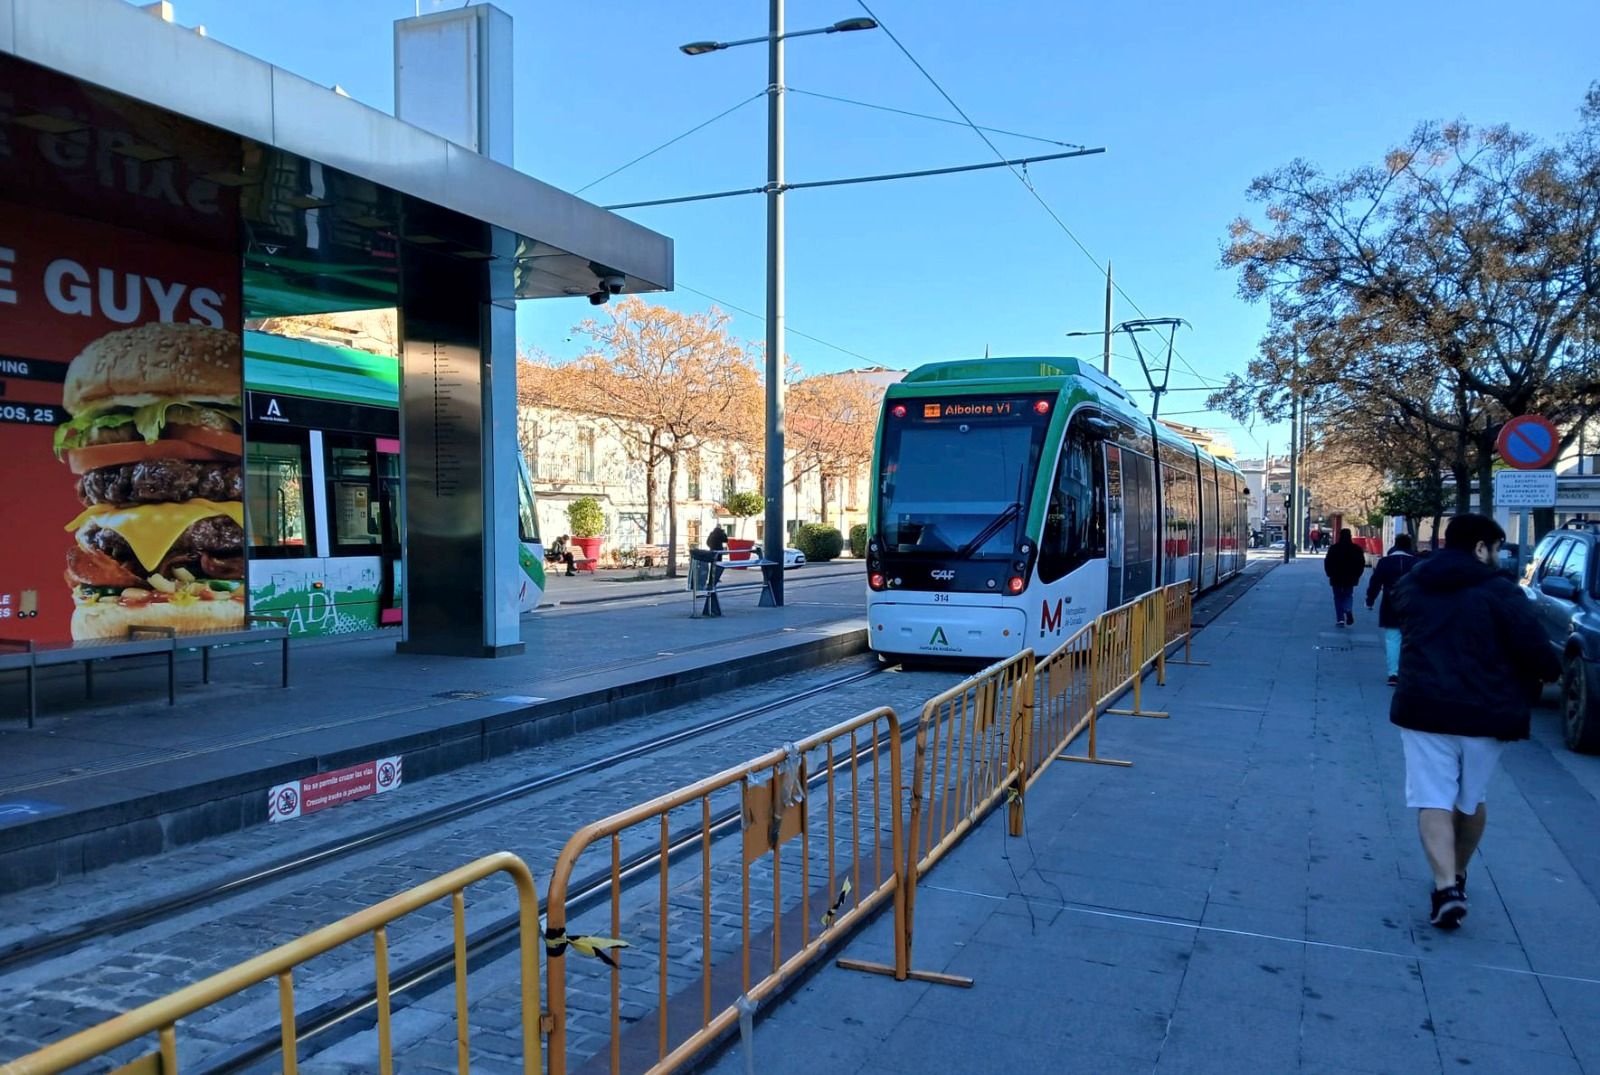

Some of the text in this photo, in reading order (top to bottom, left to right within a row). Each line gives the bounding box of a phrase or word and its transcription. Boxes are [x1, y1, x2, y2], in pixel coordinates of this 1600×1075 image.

[43, 258, 224, 330] GUYS
[0, 360, 28, 375] ING
[33, 408, 54, 422] 25
[945, 402, 1010, 415] Albolote V1
[930, 569, 956, 580] CAF
[934, 594, 949, 602] 314
[1040, 598, 1063, 638] M
[303, 783, 311, 792] No
[319, 777, 338, 787] permite
[339, 773, 354, 781] cruzar
[306, 797, 327, 807] Crossing
[328, 792, 342, 801] tracks
[348, 783, 371, 796] prohibited
